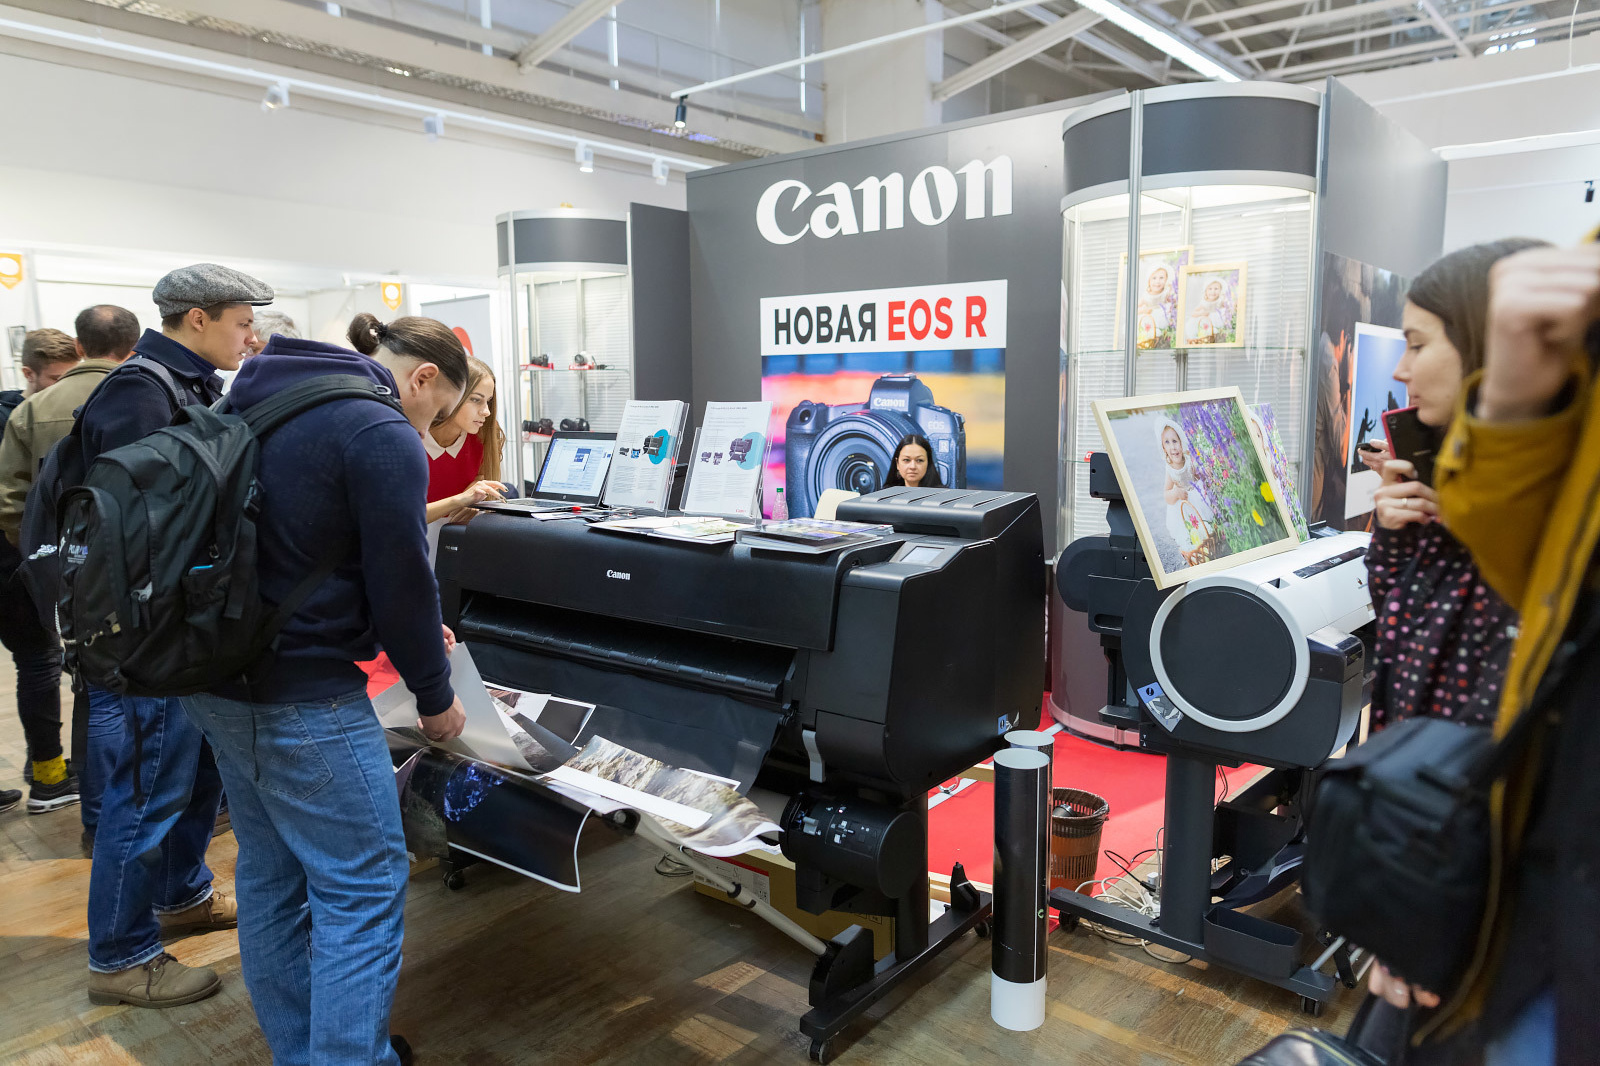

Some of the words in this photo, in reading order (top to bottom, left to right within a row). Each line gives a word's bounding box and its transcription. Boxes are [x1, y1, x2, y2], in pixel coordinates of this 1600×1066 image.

[756, 155, 1013, 245] Canon
[774, 302, 876, 345] НОВАЯ
[888, 297, 953, 341] EOS
[965, 295, 987, 337] R
[873, 397, 905, 407] Canon
[606, 569, 631, 581] Canon
